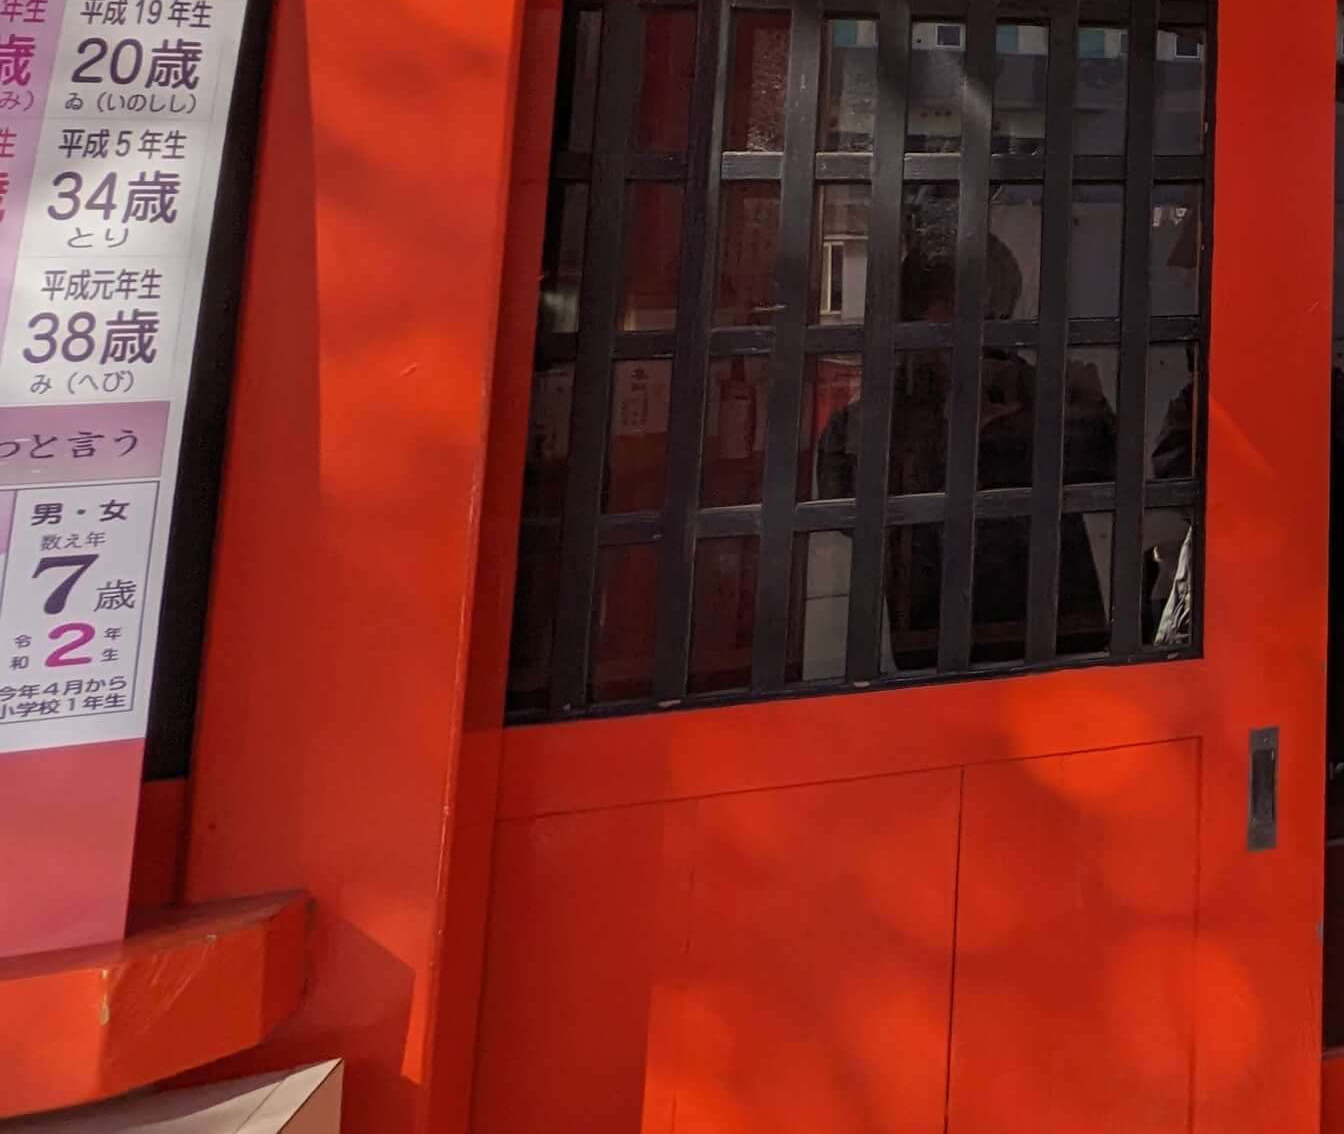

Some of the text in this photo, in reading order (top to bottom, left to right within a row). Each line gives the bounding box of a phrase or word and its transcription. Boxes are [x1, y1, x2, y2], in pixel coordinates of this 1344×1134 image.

[71, 37, 204, 91] 20歳
[57, 127, 187, 160] 平成5年生
[46, 169, 182, 225] 34歳
[66, 226, 130, 249] とり
[41, 267, 163, 301] 平成元年生
[22, 307, 161, 365] 38歳
[31, 498, 130, 526] 男・女
[40, 531, 107, 552] 数え年
[31, 553, 137, 615] 7歳
